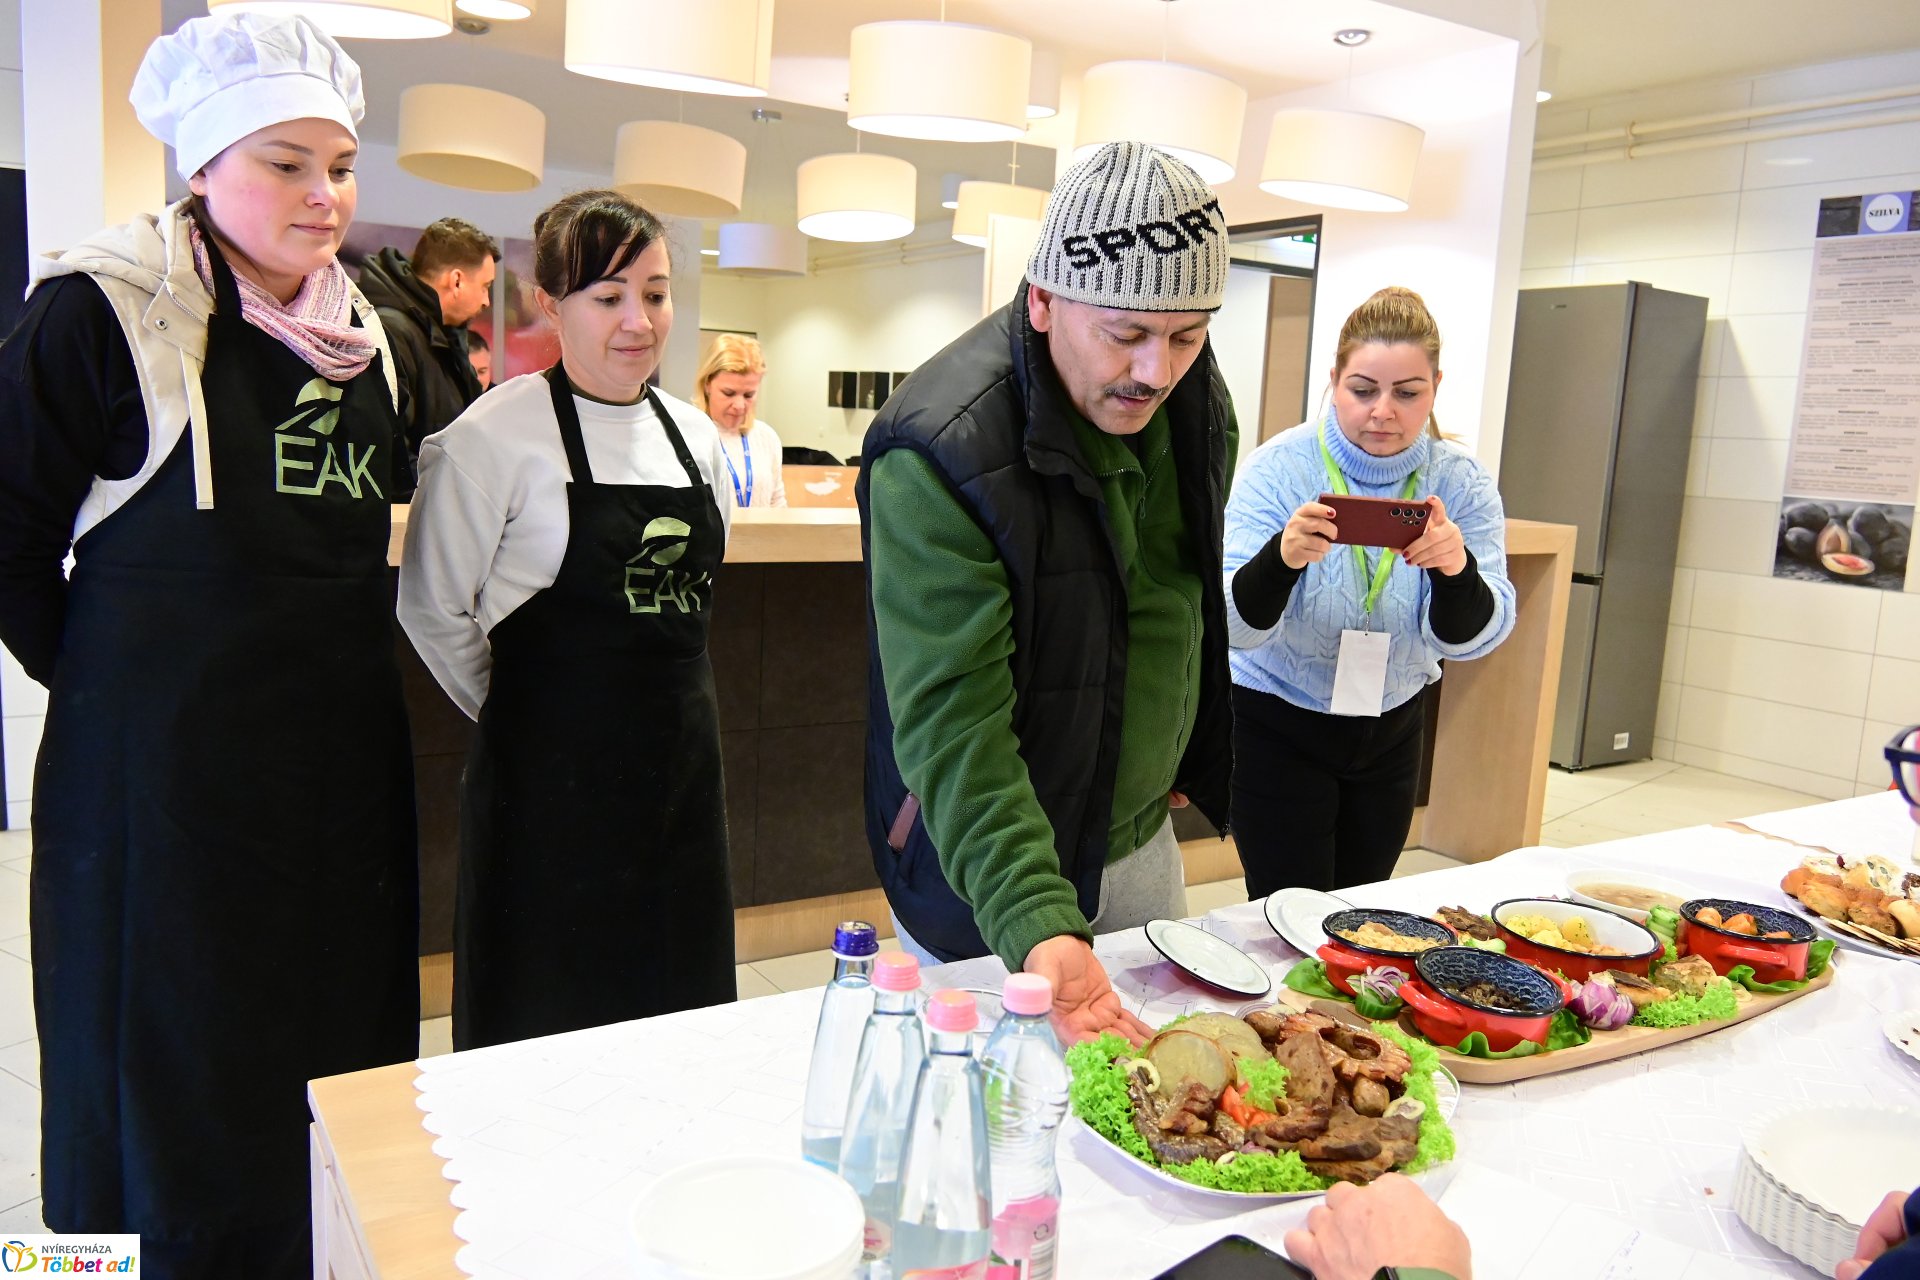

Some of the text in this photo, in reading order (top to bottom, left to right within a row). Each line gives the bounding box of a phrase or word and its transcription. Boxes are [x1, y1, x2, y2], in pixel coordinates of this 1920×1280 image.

[1062, 198, 1225, 270] SPORT
[1868, 207, 1900, 218] SZILVA
[275, 432, 384, 500] EAK
[625, 566, 708, 614] EAK
